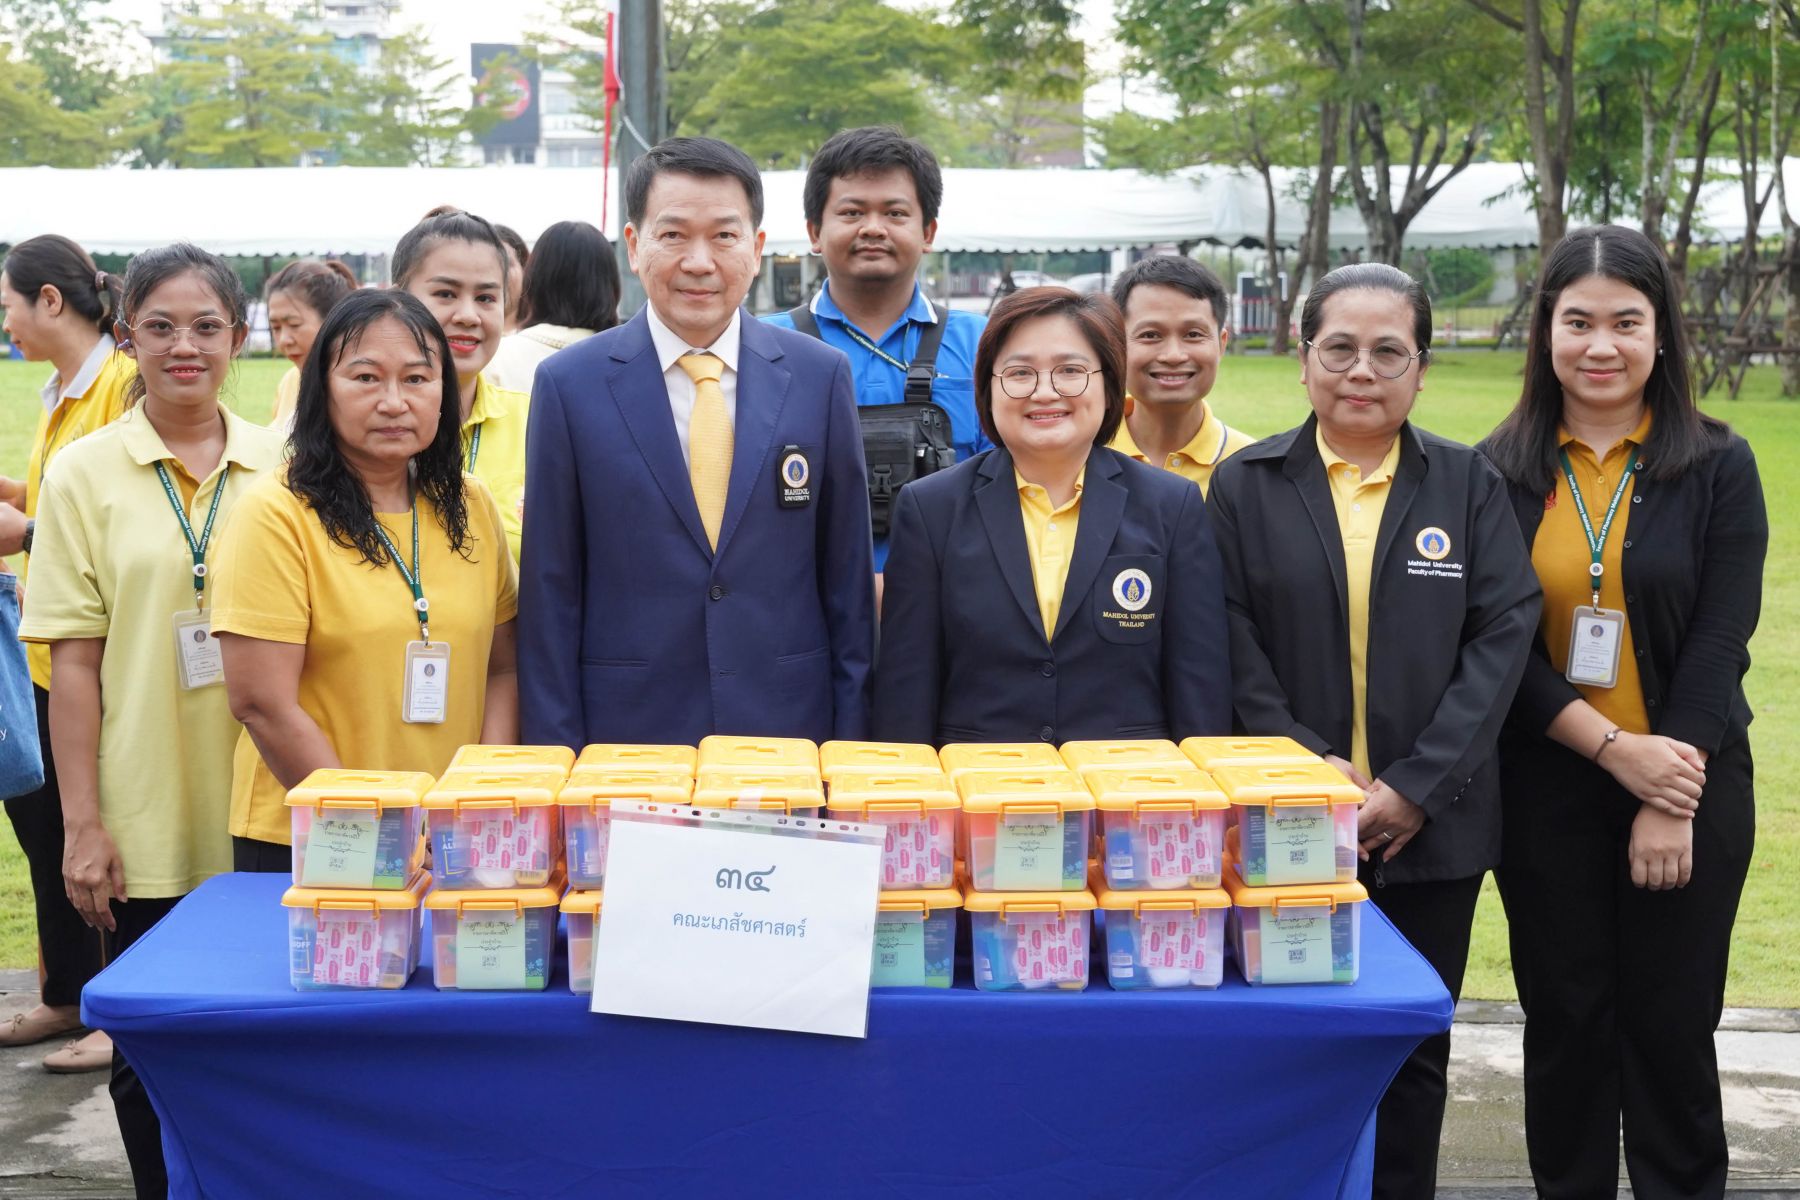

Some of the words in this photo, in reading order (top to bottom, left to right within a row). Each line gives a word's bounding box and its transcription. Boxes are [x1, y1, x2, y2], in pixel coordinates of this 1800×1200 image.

[159, 467, 168, 483] Faculty
[168, 488, 181, 511] Pharmacy
[178, 509, 190, 528] Mahidol
[187, 528, 199, 552] University
[1568, 473, 1577, 490] Faculty
[1575, 492, 1585, 513] Pharmacy
[1582, 513, 1592, 531] Mahidol
[1596, 535, 1606, 552] Faculty
[1603, 508, 1615, 530] Pharmacy
[1611, 491, 1621, 509] Mahidol
[1618, 471, 1631, 492] University
[200, 537, 208, 553] Faculty
[207, 509, 216, 531] Pharmacy
[389, 543, 402, 562] Mahidol
[400, 562, 414, 584] University
[1407, 568, 1428, 576] Faculty
[1434, 570, 1463, 578] Pharmacy
[1432, 561, 1462, 570] University
[1103, 611, 1129, 619] MAHIDOL
[716, 864, 776, 892] ๓๔
[672, 911, 808, 938] คณะเภสัชศาสตร์
